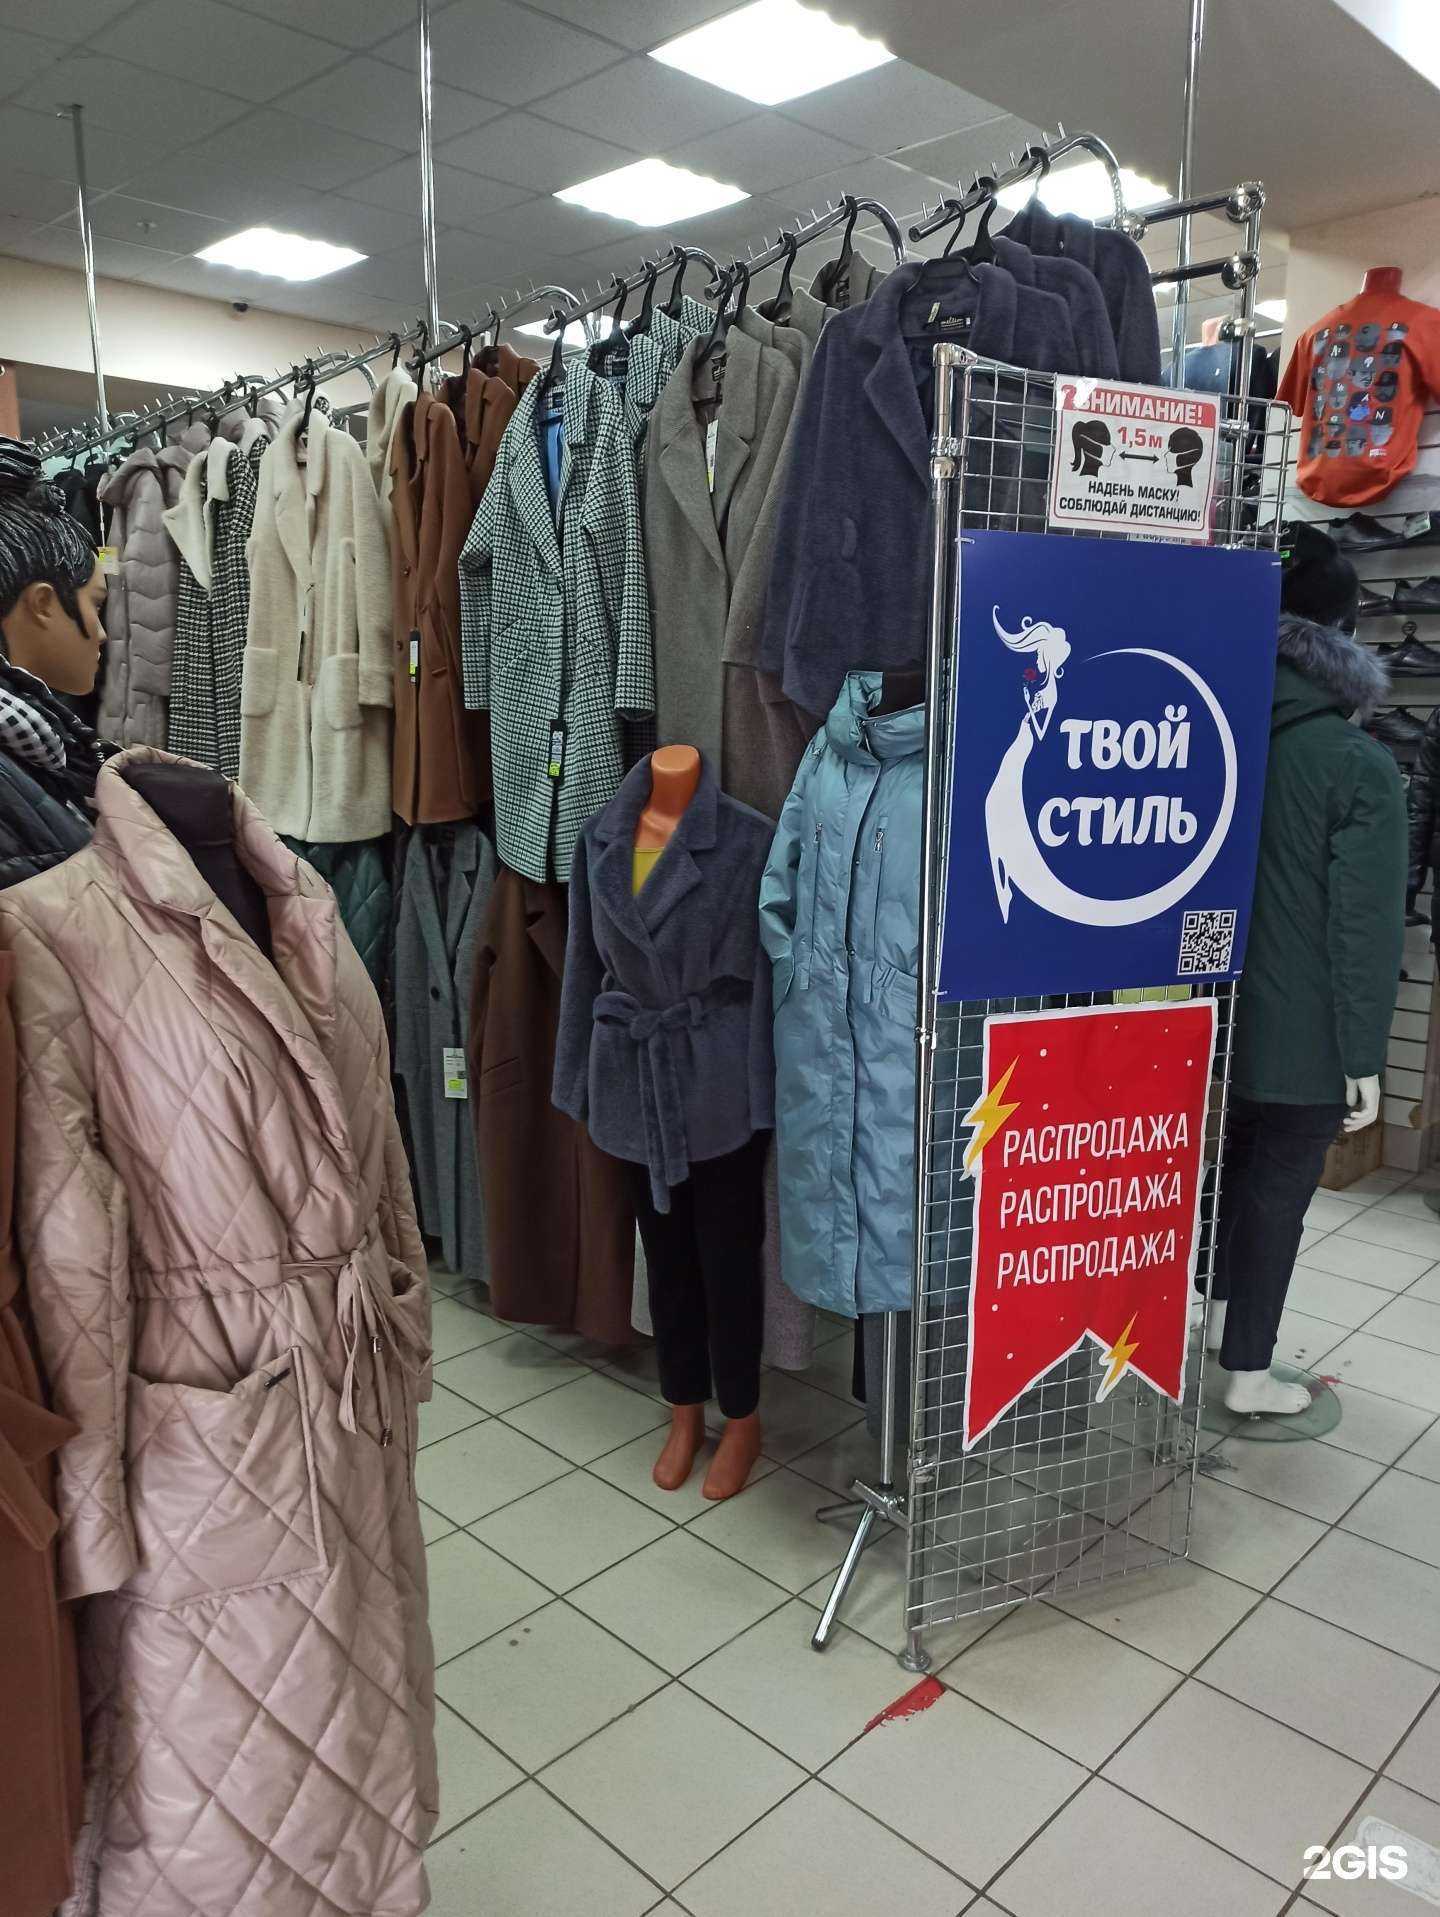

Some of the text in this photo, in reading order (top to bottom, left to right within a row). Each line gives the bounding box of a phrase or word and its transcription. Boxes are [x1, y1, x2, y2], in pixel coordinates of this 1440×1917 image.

[1059, 496, 1201, 523] СОБЛЮДАЙ ДИСТАНЦИЮ!
[1088, 480, 1180, 503] НАДЕНЬ МАСКУ!
[1060, 704, 1191, 770] ТВОЙ
[1038, 795, 1198, 847] СТИЛЬ
[1002, 1112, 1190, 1168] РАСПРОДАЖА
[999, 1171, 1182, 1230] РАСПРОДАЖА
[996, 1229, 1176, 1289] РАСПРОДАЖА
